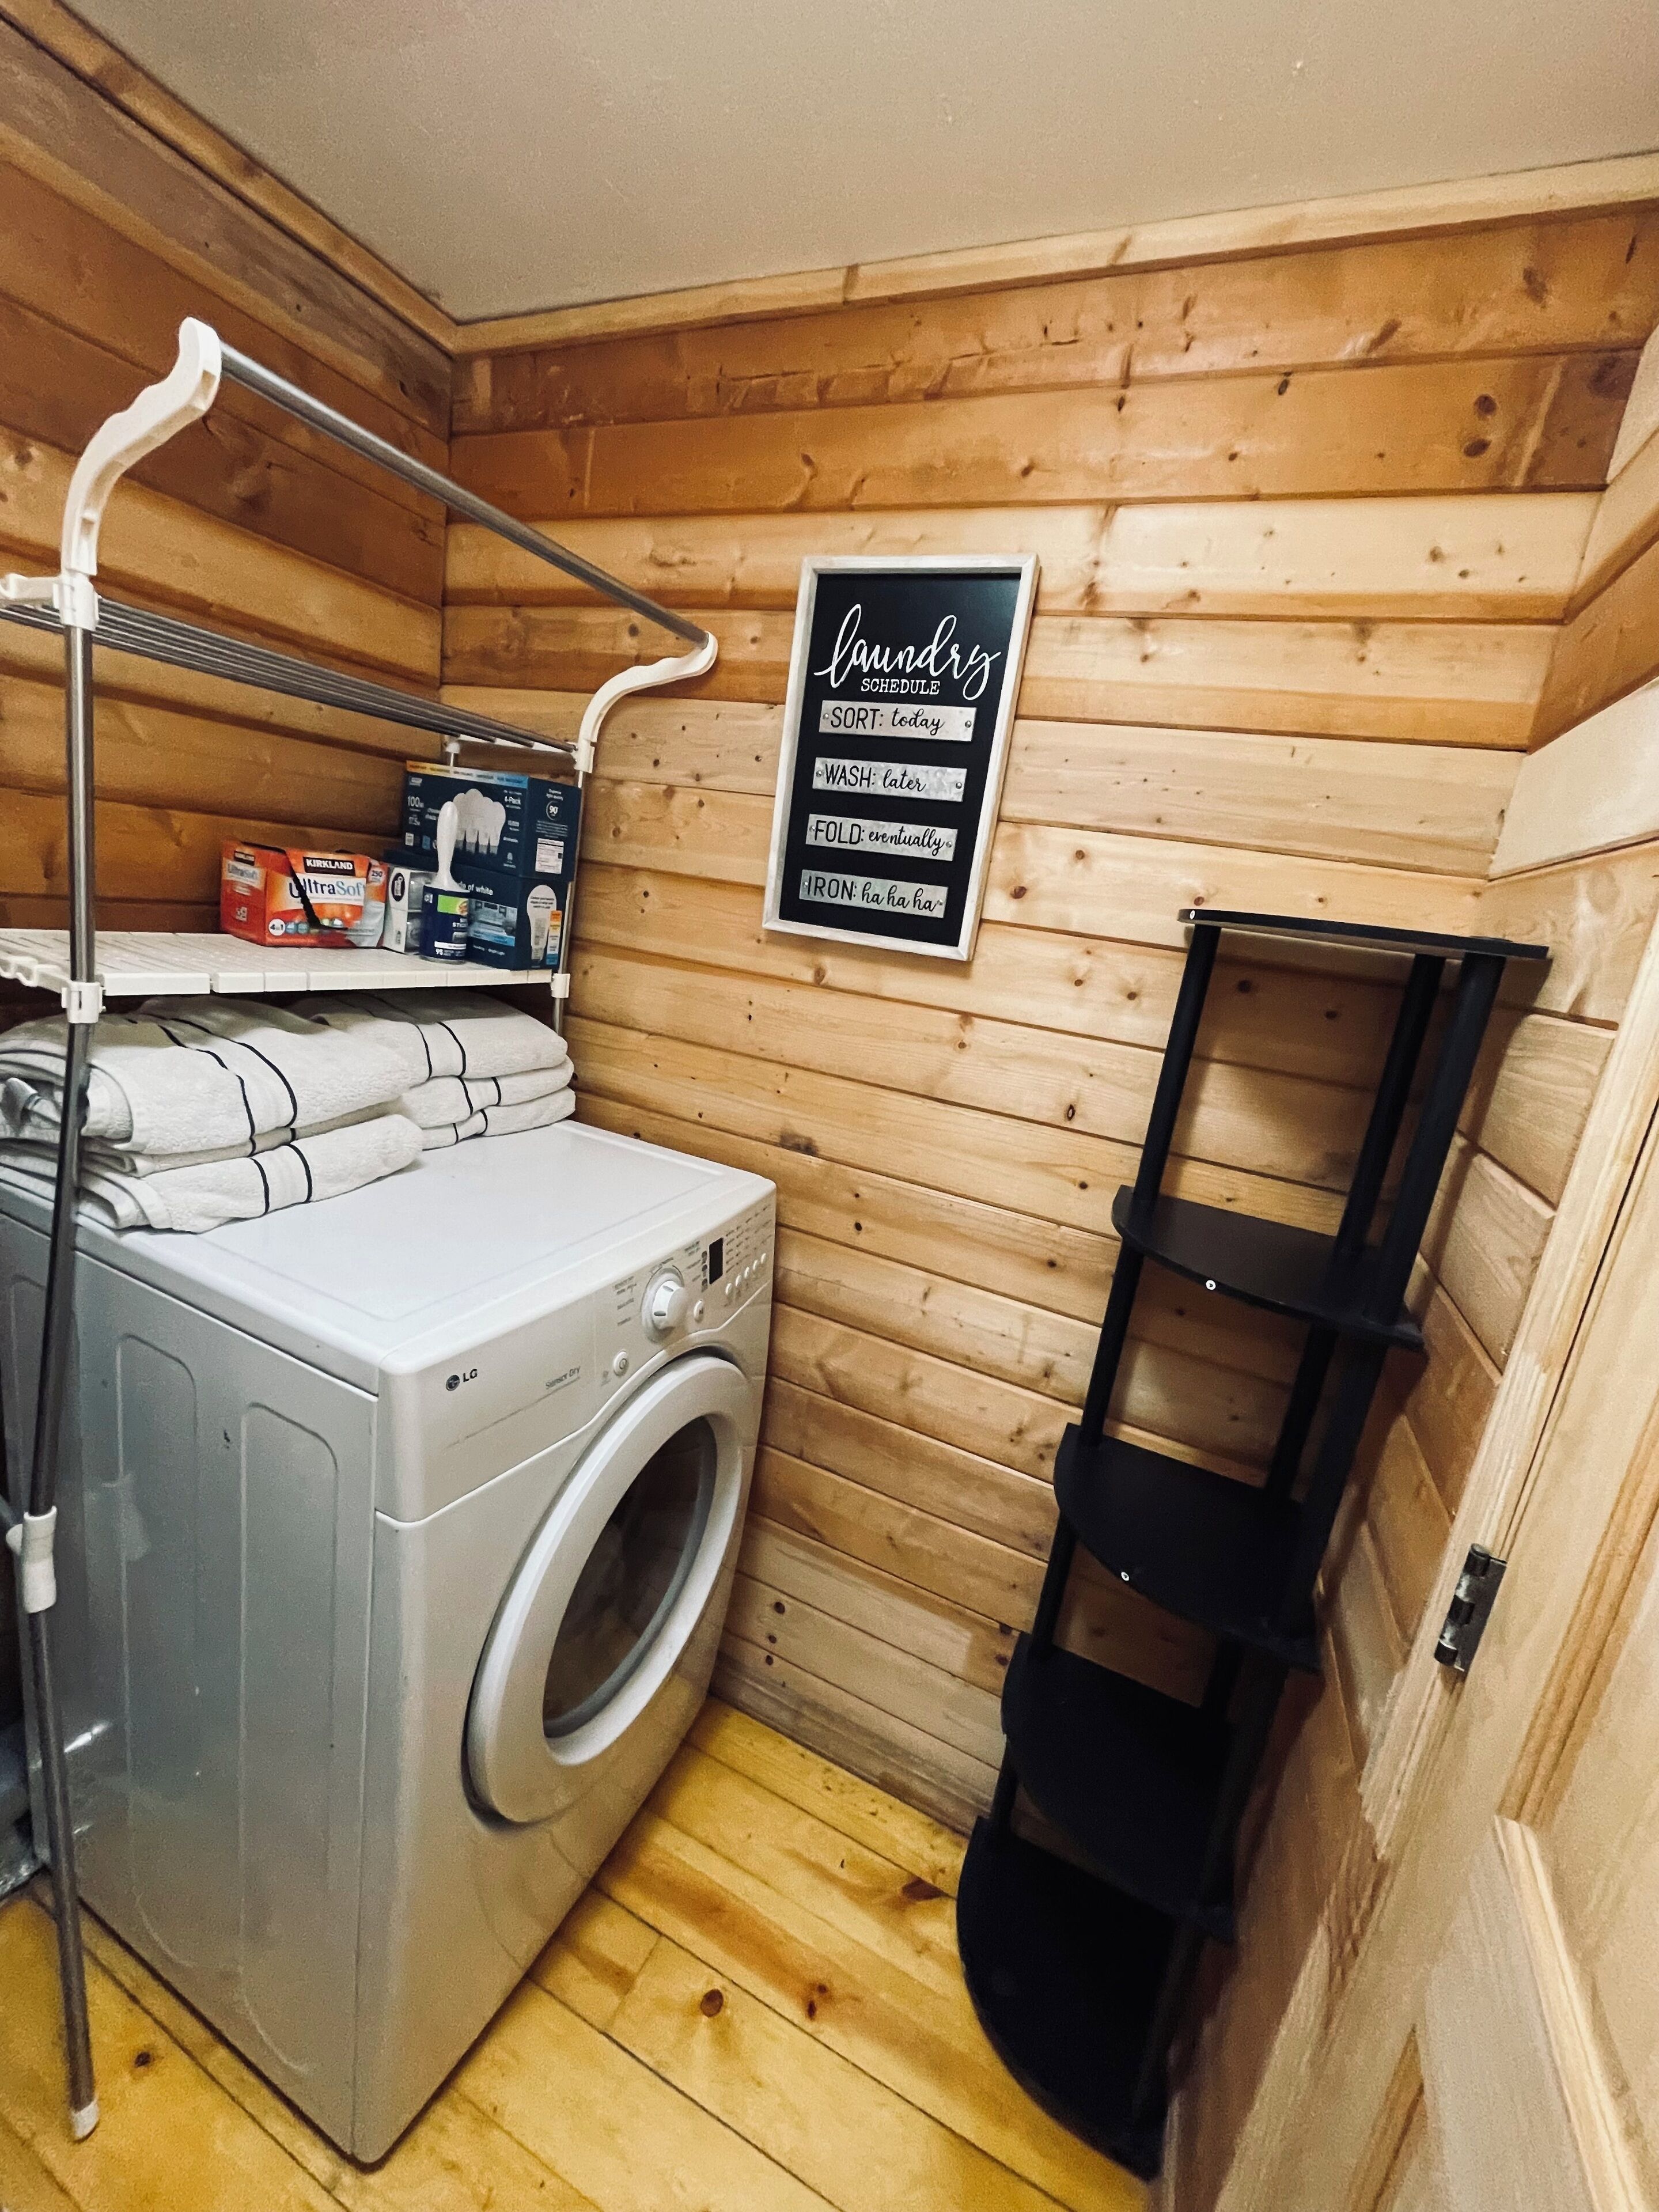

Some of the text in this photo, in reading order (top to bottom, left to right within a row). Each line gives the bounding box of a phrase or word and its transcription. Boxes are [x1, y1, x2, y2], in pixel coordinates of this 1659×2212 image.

[813, 603, 1002, 700] laundry
[861, 677, 941, 695] SCHEDULE
[830, 706, 946, 736] SORT: today
[825, 763, 926, 792] WASH: later
[815, 820, 945, 857] FOLD: eventually
[306, 858, 353, 870] KIRKLAND
[807, 876, 937, 912] IRON: ha ha ha
[463, 1368, 478, 1382] LG
